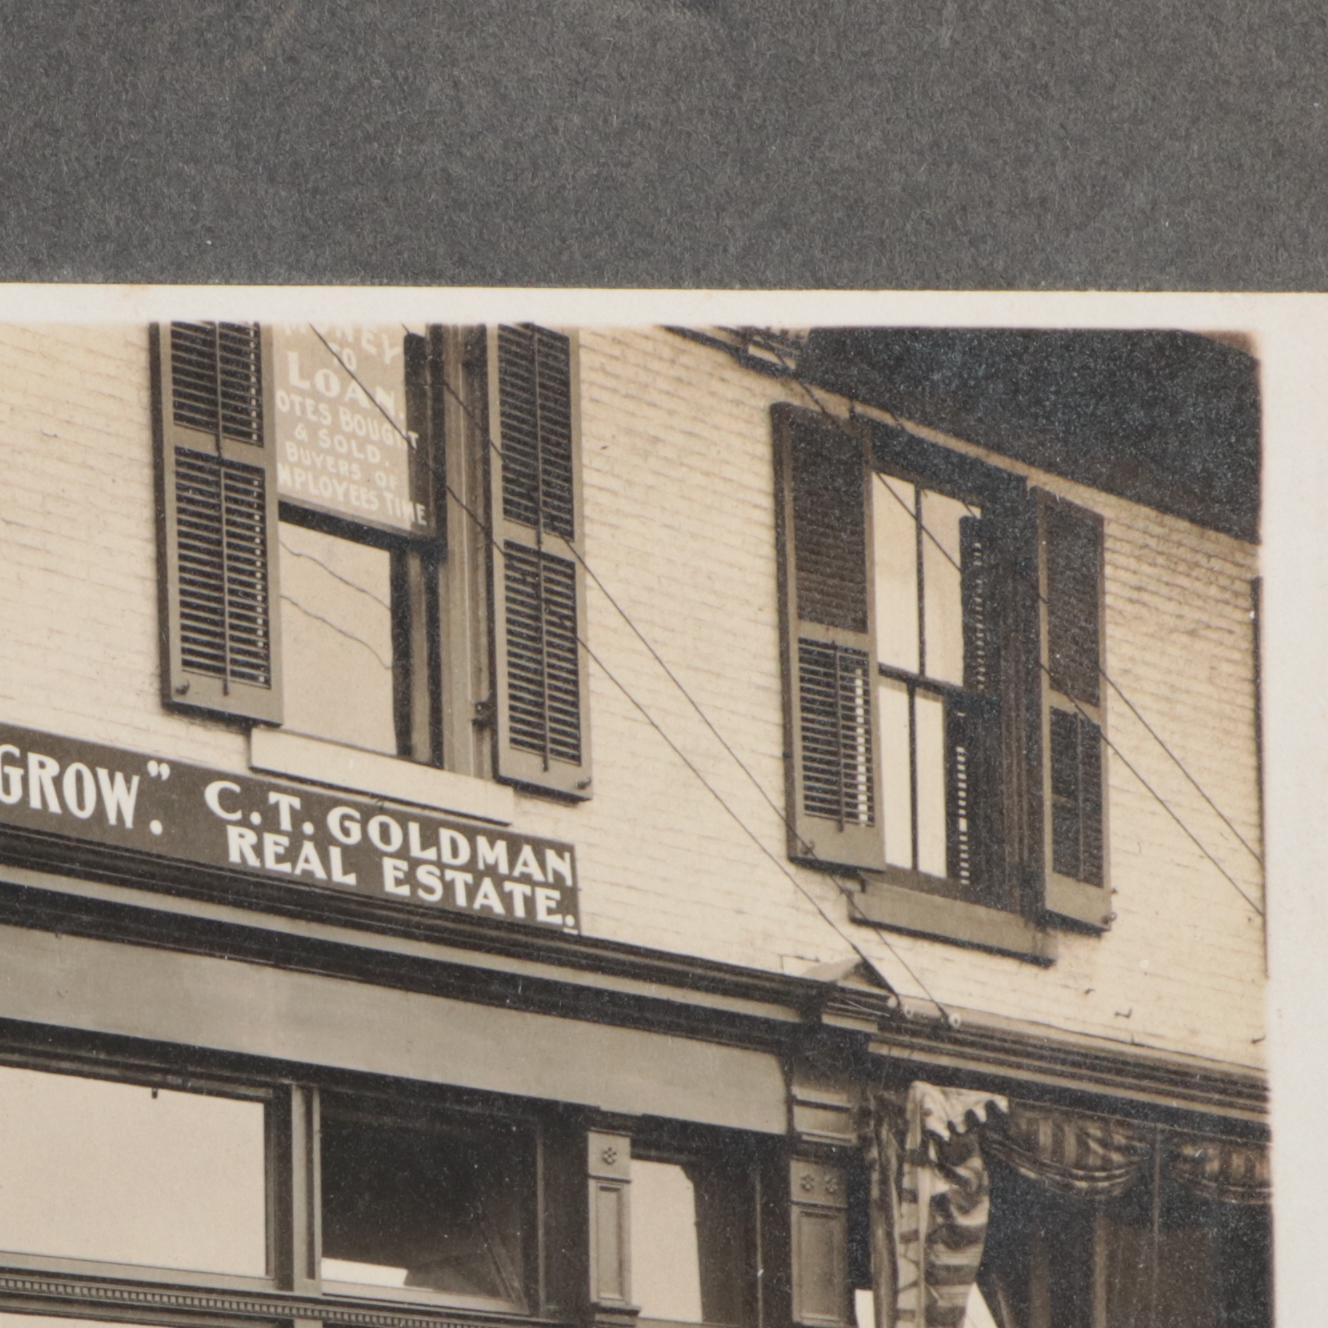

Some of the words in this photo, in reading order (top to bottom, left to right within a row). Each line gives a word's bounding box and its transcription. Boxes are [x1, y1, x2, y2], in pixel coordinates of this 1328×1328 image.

[226, 824, 357, 888] REAL
[383, 856, 576, 926] ESTATE.
[328, 804, 574, 887] GOLDMAN
